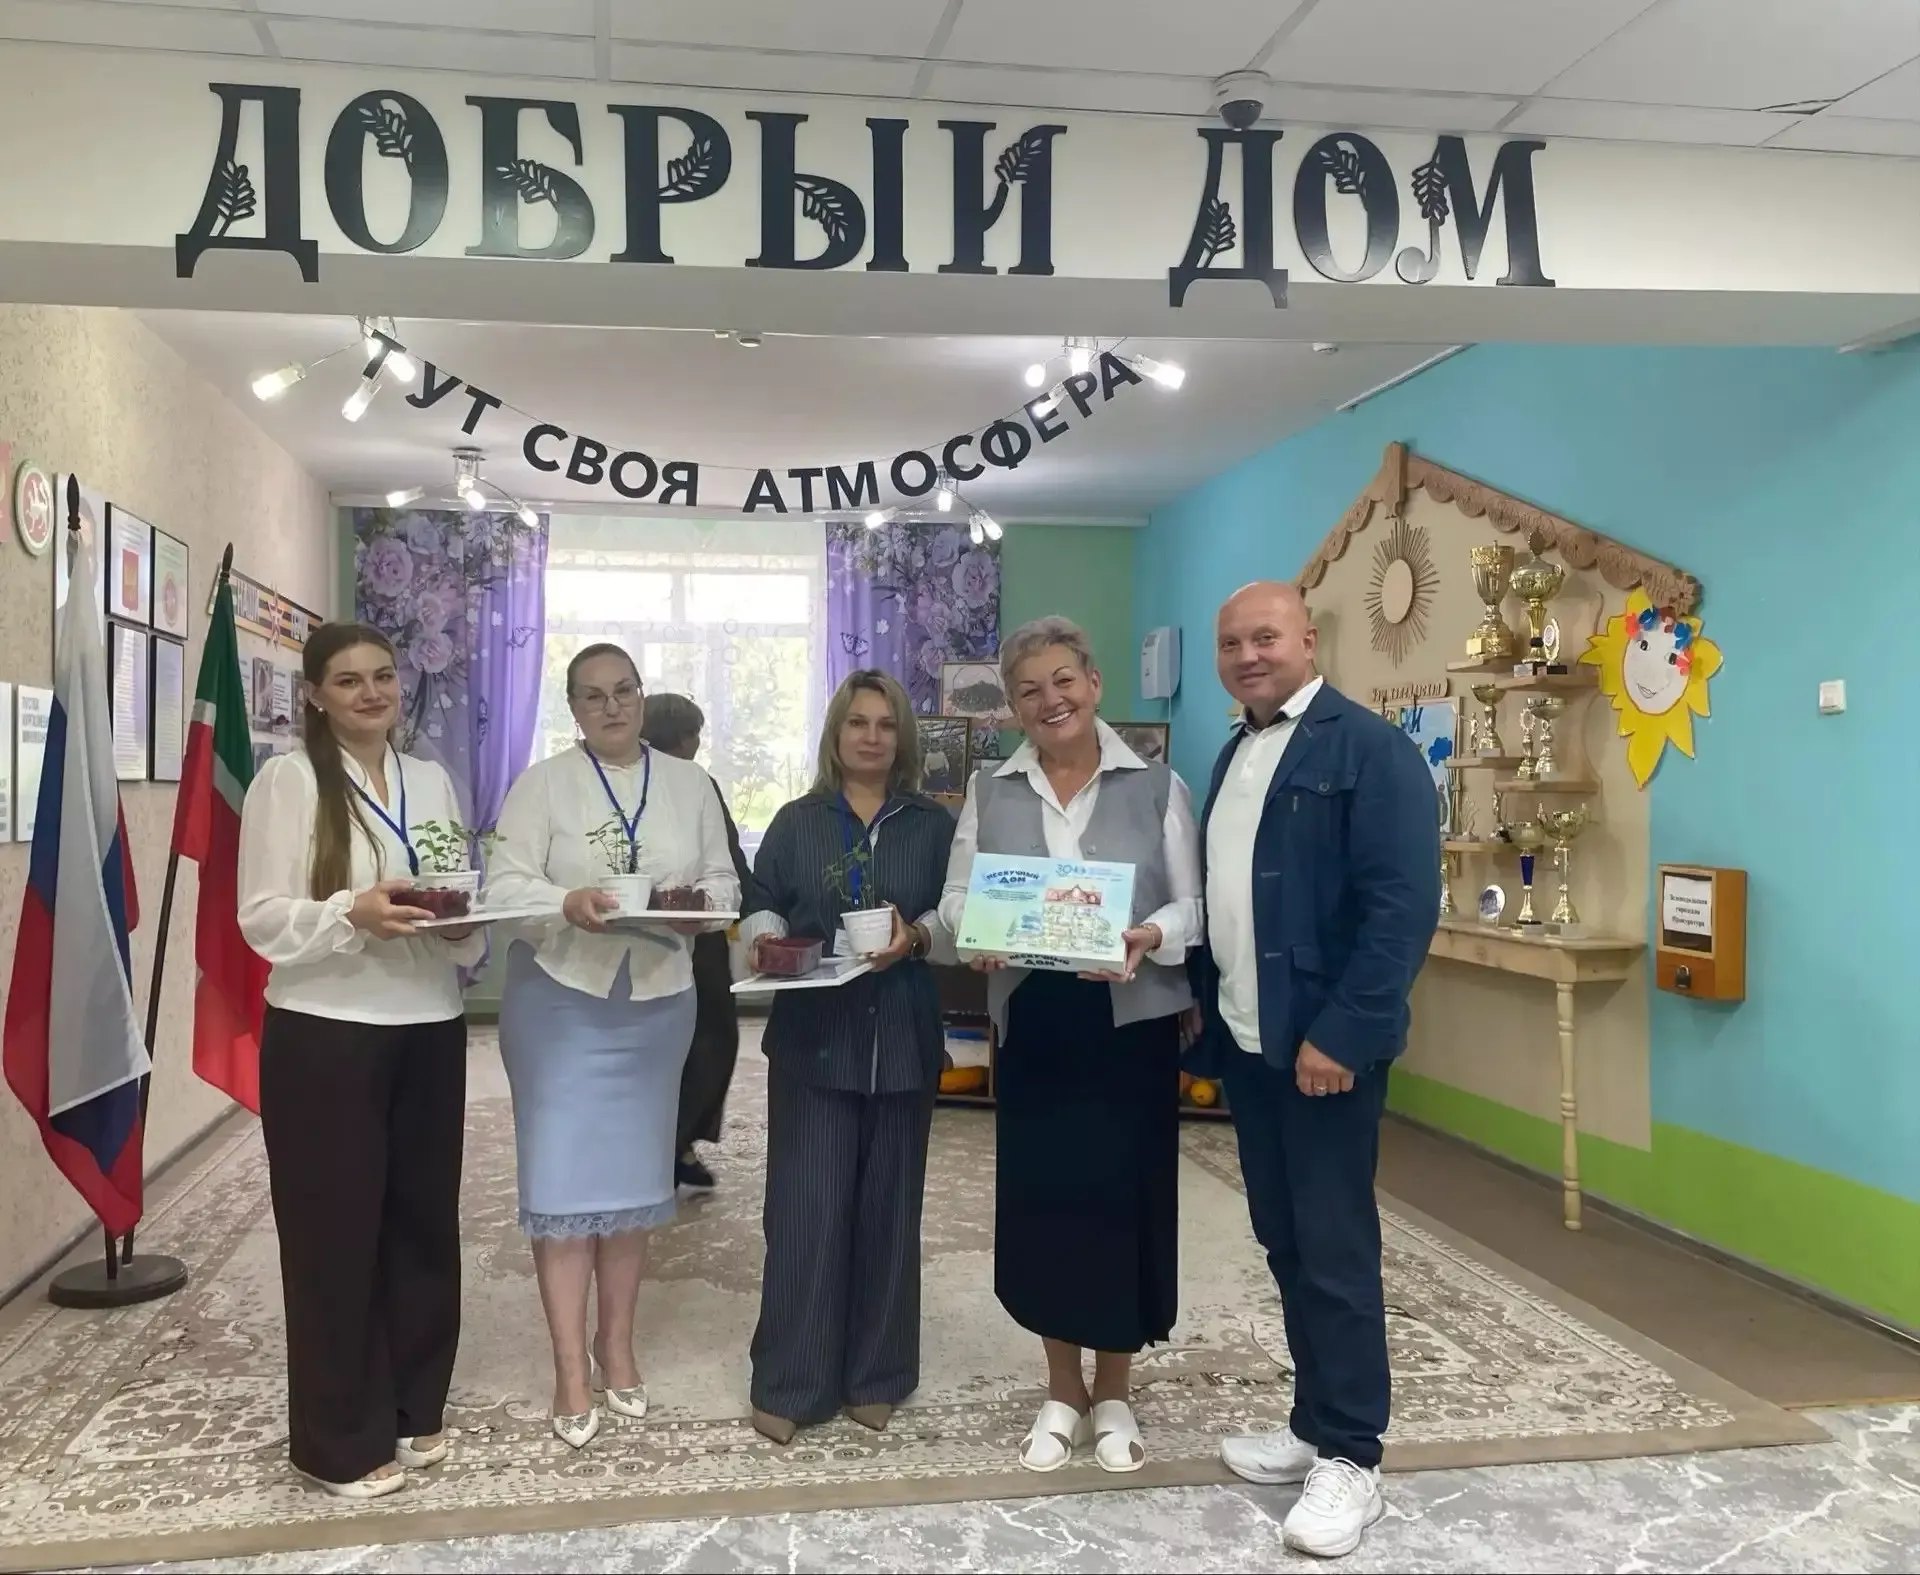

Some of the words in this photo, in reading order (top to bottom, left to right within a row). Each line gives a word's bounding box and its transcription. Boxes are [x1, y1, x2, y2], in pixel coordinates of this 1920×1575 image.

[1169, 128, 1555, 309] ДОМ
[363, 329, 502, 435] ТУТ
[522, 424, 699, 506] СВОЯ
[742, 351, 1143, 514] АТМОСФЕРА
[999, 876, 1026, 884] ДОМ
[1024, 959, 1055, 967] ДОМ
